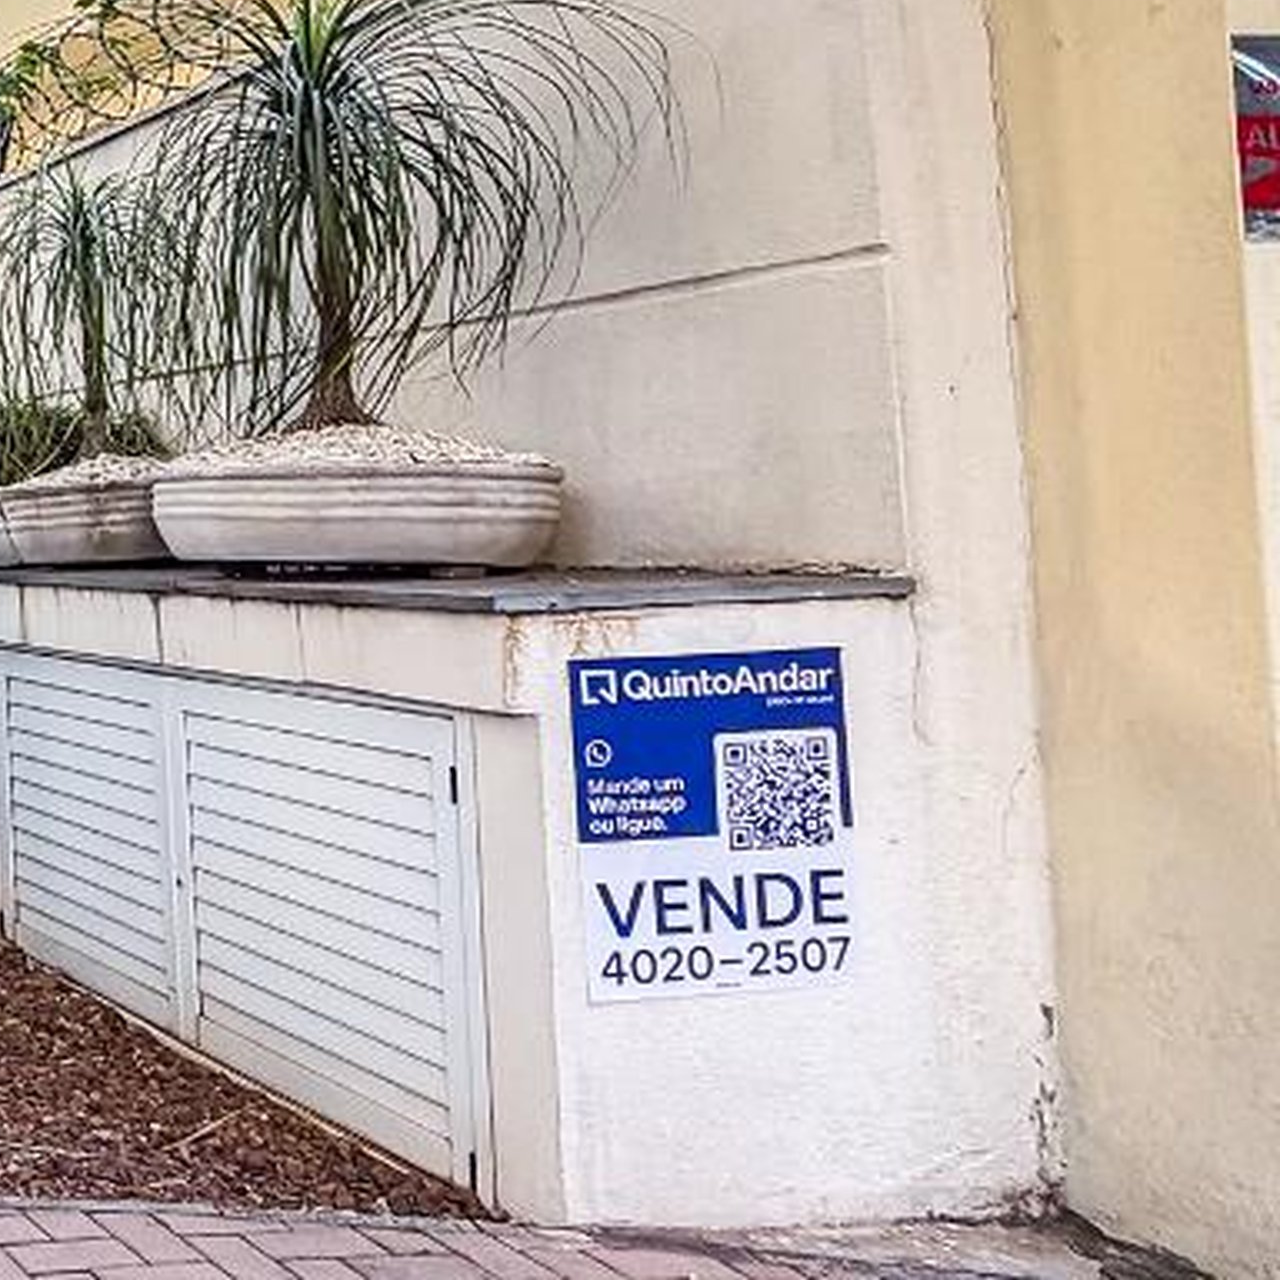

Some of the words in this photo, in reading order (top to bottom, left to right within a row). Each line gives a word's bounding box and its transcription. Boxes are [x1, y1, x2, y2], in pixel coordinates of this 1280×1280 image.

[622, 663, 834, 701] QuintoAndar
[588, 777, 651, 795] Mande
[653, 778, 685, 793] um
[589, 819, 614, 834] ou
[596, 869, 849, 938] VENDE
[602, 937, 851, 985] 4020-2507
